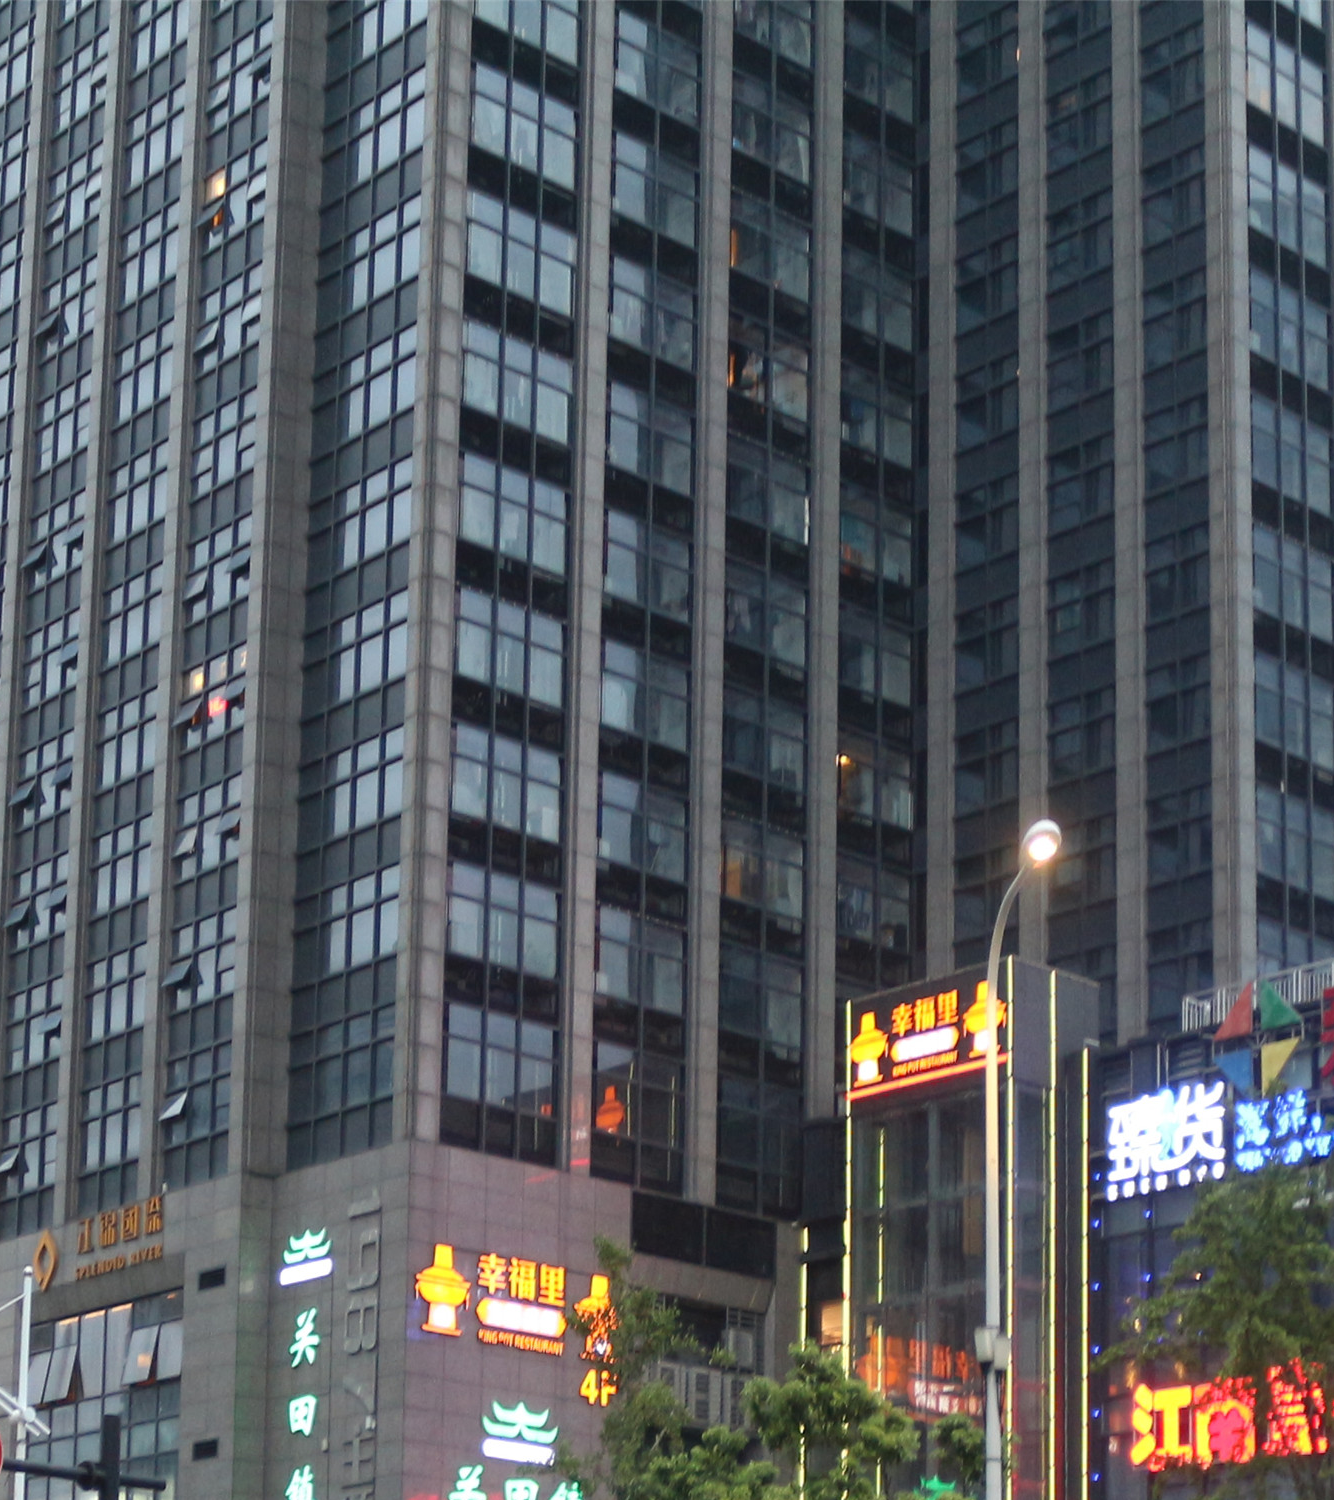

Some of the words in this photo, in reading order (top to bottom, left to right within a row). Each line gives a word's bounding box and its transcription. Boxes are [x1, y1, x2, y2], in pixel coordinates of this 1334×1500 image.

[892, 989, 959, 1037] 幸福里
[76, 1254, 126, 1281] SPLENDID
[130, 1244, 163, 1266] RIVER
[477, 1253, 566, 1307] 幸福里
[477, 1328, 498, 1345] KING
[498, 1331, 515, 1348] POT
[515, 1335, 565, 1357] RESTAURANT
